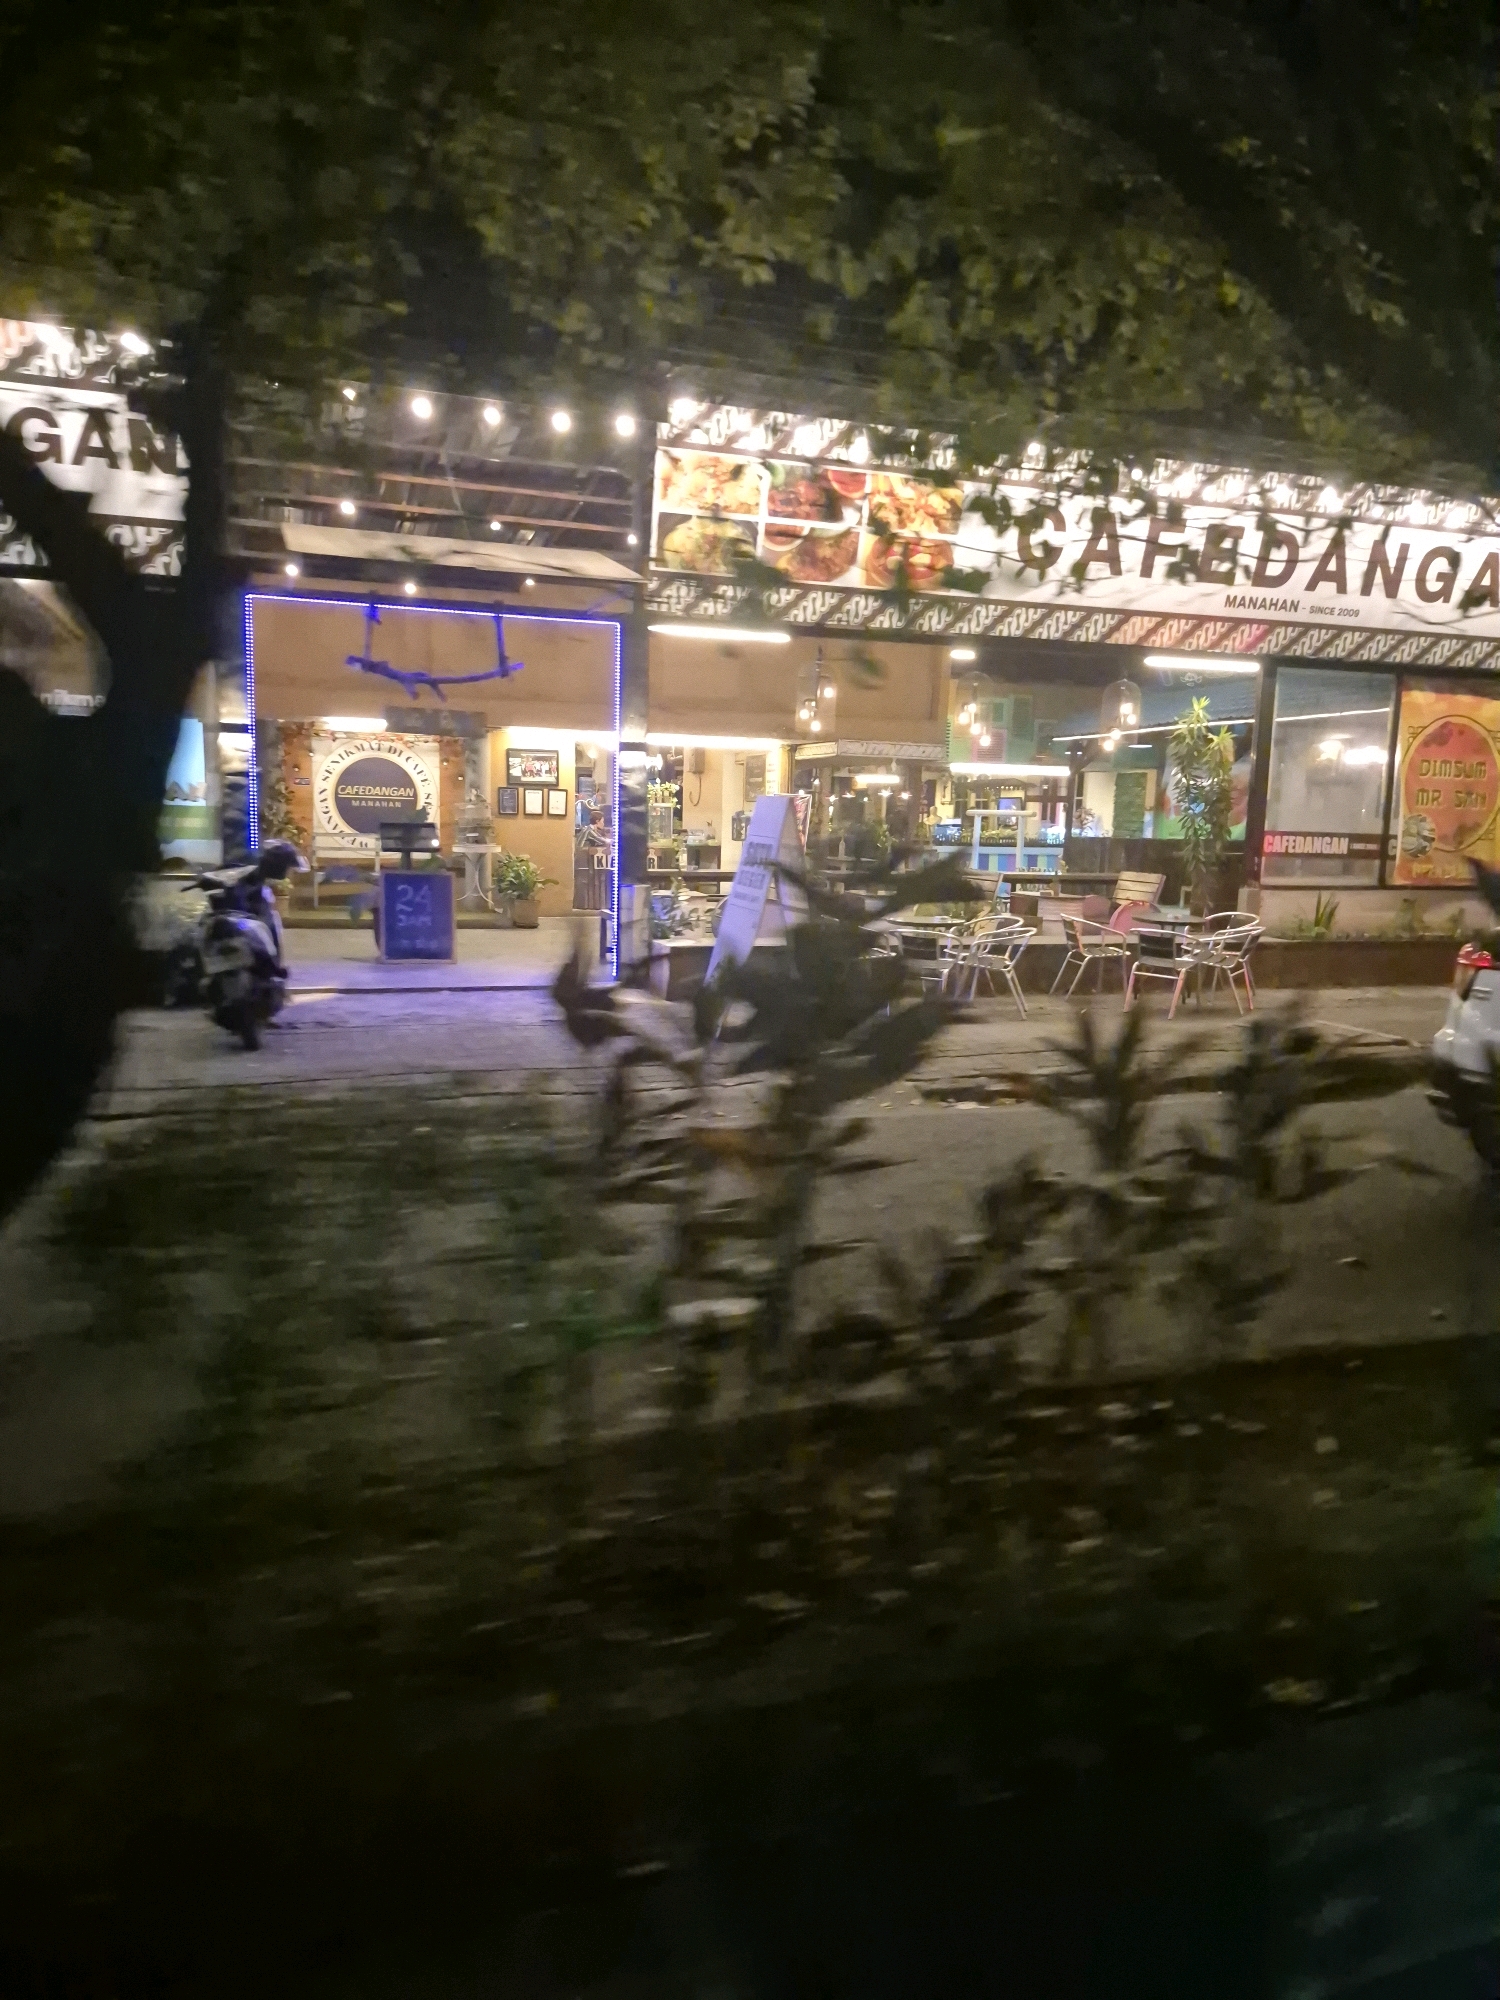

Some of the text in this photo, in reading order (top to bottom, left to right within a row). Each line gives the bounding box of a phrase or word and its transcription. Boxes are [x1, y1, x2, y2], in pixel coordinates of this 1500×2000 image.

[1224, 594, 1300, 613] MANAHAN
[1309, 605, 1336, 616] SINCE
[1337, 607, 1361, 618] 2009
[1419, 759, 1487, 779] DIMSUM
[338, 785, 414, 797] CAFEDANGAN
[1416, 788, 1441, 807] MR
[351, 800, 401, 808] MANAHAN
[1264, 835, 1349, 855] CAFEDANGAN
